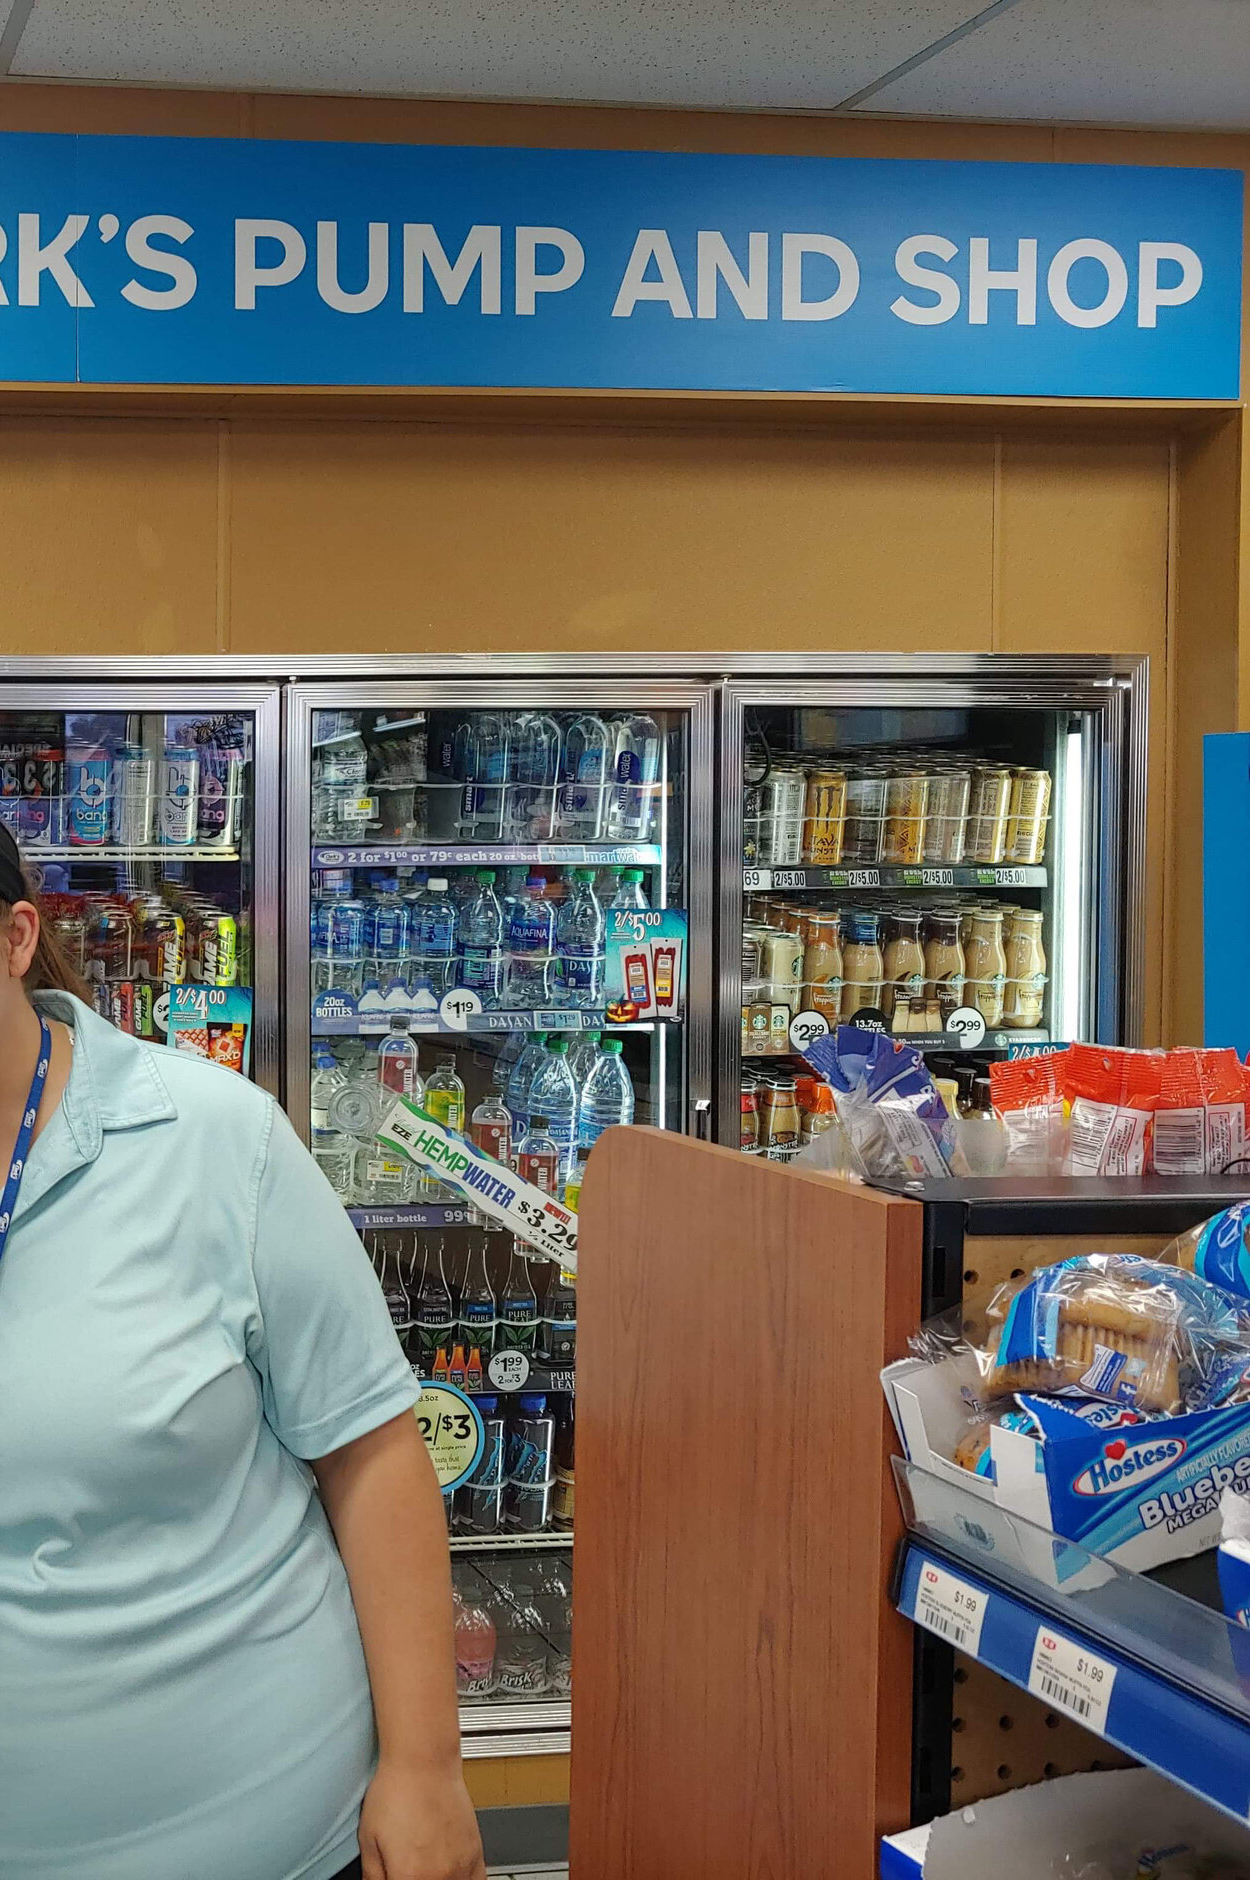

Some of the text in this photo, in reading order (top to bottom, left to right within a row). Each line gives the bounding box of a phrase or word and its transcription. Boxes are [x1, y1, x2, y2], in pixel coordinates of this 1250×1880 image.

[235, 219, 585, 317] PUMP
[611, 229, 860, 322] AND
[890, 234, 1204, 330] SHOP
[348, 852, 357, 863] 2
[360, 852, 381, 863] for
[412, 854, 426, 863] or
[456, 850, 487, 862] each
[489, 853, 501, 861] 20
[774, 872, 806, 886] 2/$5.00
[849, 870, 879, 886] 2/$5.00
[923, 869, 953, 885] 2/$5.00
[996, 869, 1026, 884] 2/$5.00
[511, 925, 549, 939] AQUAFINA
[323, 996, 346, 1006] 20oz
[315, 1006, 353, 1018] BOTTLES
[855, 1019, 883, 1029] 13.7oz
[390, 1123, 413, 1141] EZE
[363, 1215, 370, 1224] 1
[372, 1214, 395, 1224] liter
[396, 1213, 427, 1223] bottle
[423, 1315, 447, 1323] PURE
[469, 1314, 491, 1322] PURE
[508, 1310, 532, 1318] PURE
[497, 1375, 505, 1385] 2
[511, 1373, 521, 1383] $3
[1087, 1440, 1179, 1493] Hostess
[953, 1590, 977, 1612] $1.99
[1076, 1658, 1104, 1683] $1.99
